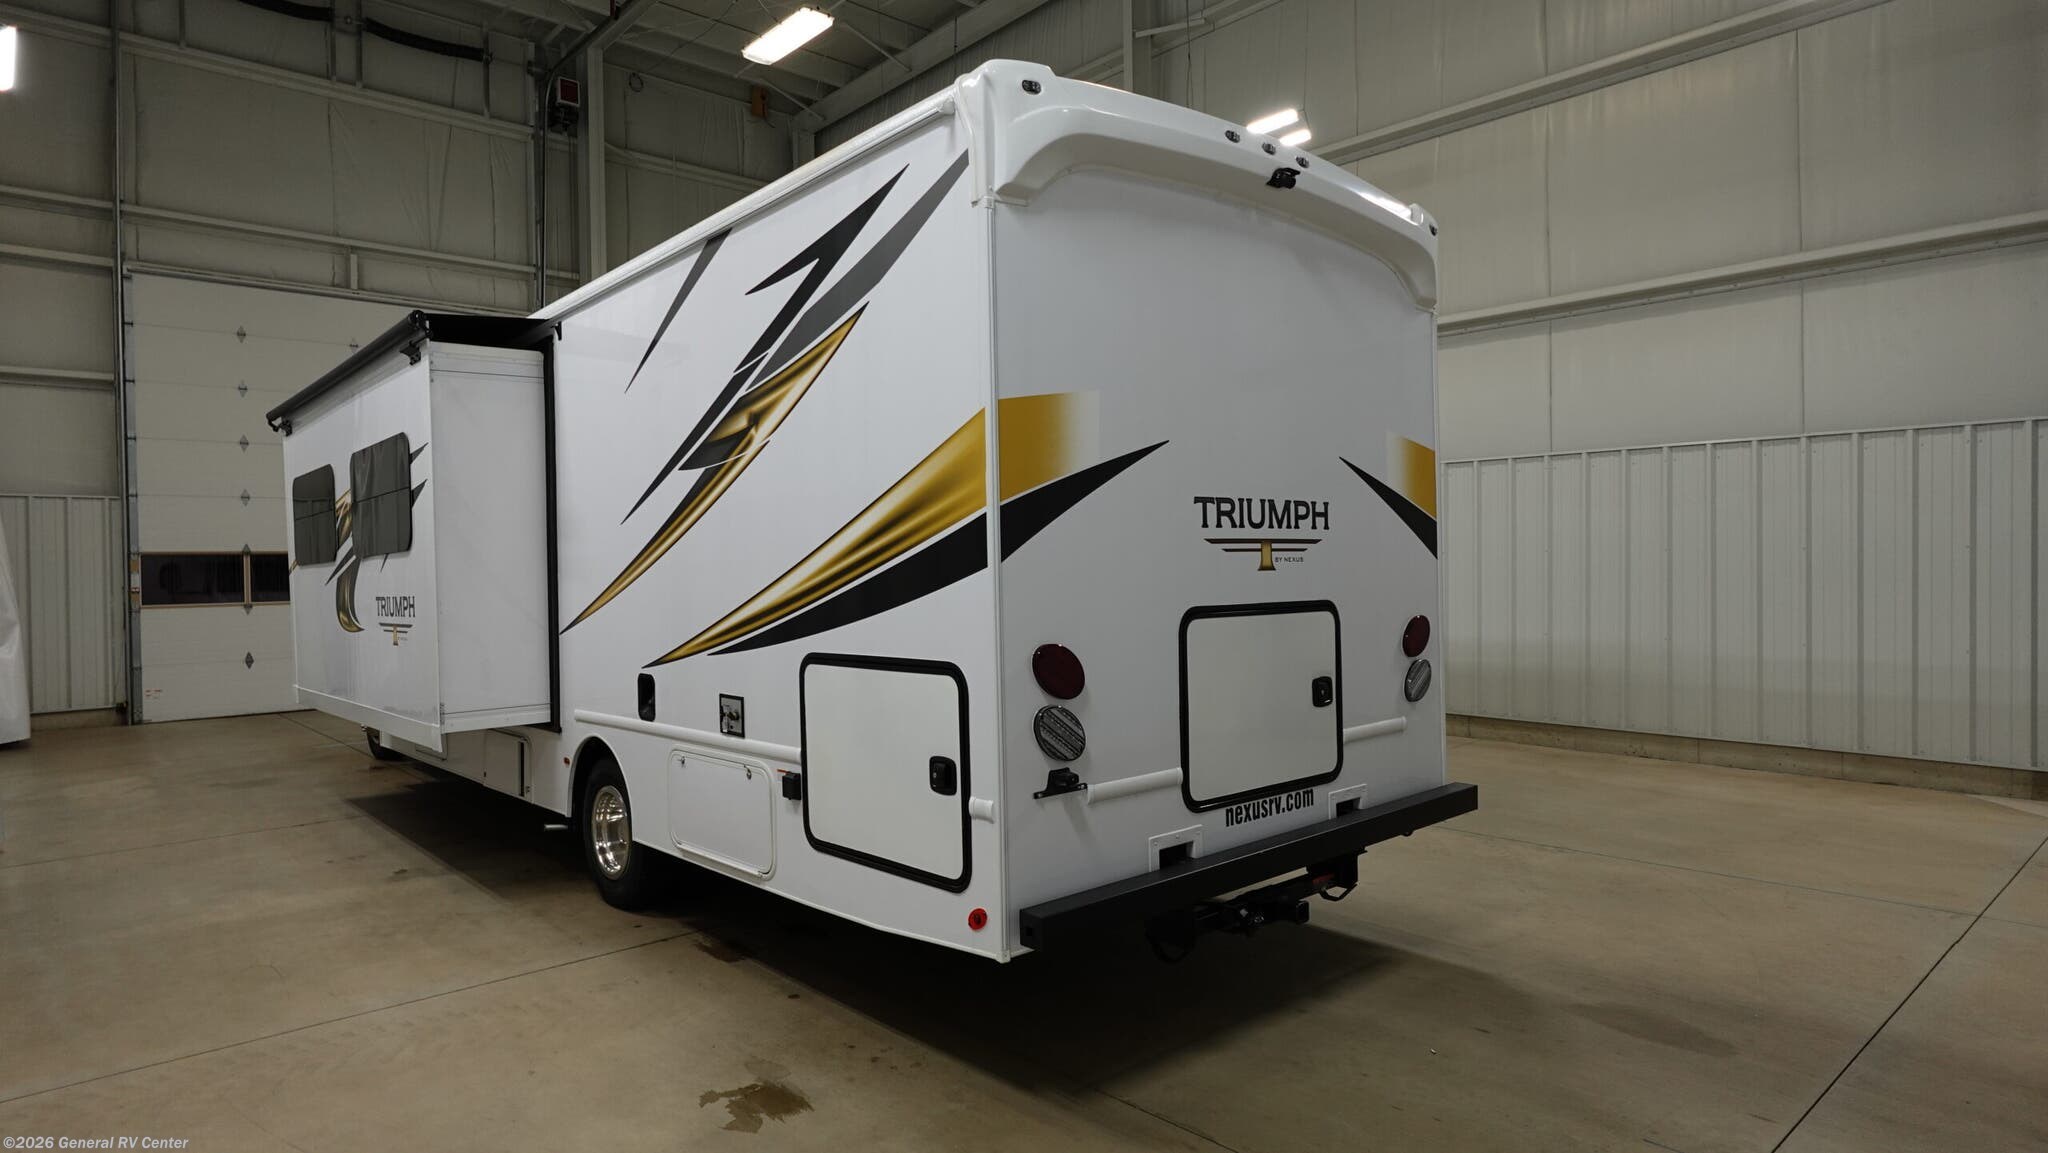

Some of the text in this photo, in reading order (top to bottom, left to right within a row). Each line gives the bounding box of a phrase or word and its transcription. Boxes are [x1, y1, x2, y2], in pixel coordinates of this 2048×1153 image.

[1194, 496, 1330, 530] TRIUMPH
[375, 596, 416, 617] TRIUMPH
[1225, 788, 1314, 827] nexusrv.com
